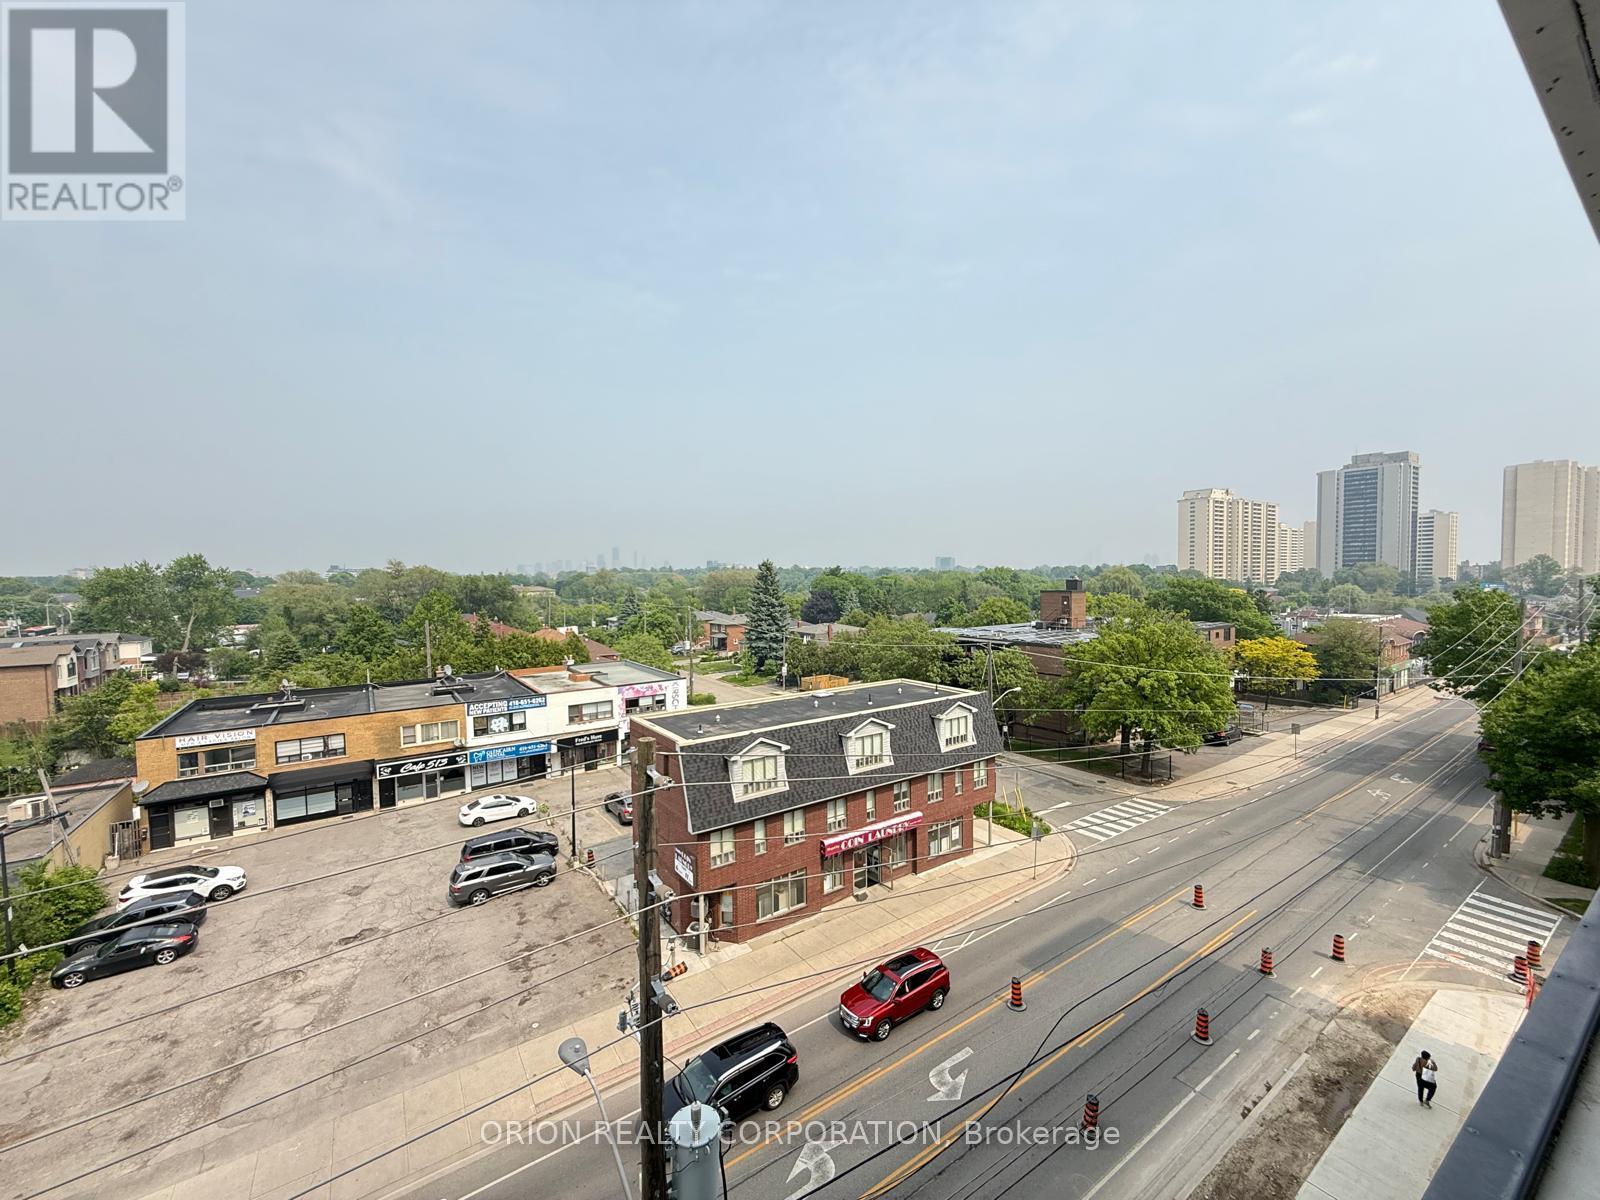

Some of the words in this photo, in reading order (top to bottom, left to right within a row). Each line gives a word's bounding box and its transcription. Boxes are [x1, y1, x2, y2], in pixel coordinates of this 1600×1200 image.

[469, 701, 508, 710] ACCEPTING
[469, 708, 483, 716] NEW
[483, 706, 508, 714] PATIENTS
[179, 735, 208, 743] HAIR
[214, 730, 253, 739] VISION
[426, 758, 449, 770] 513
[840, 836, 865, 850] COIN
[868, 821, 910, 841] LAUNDRY
